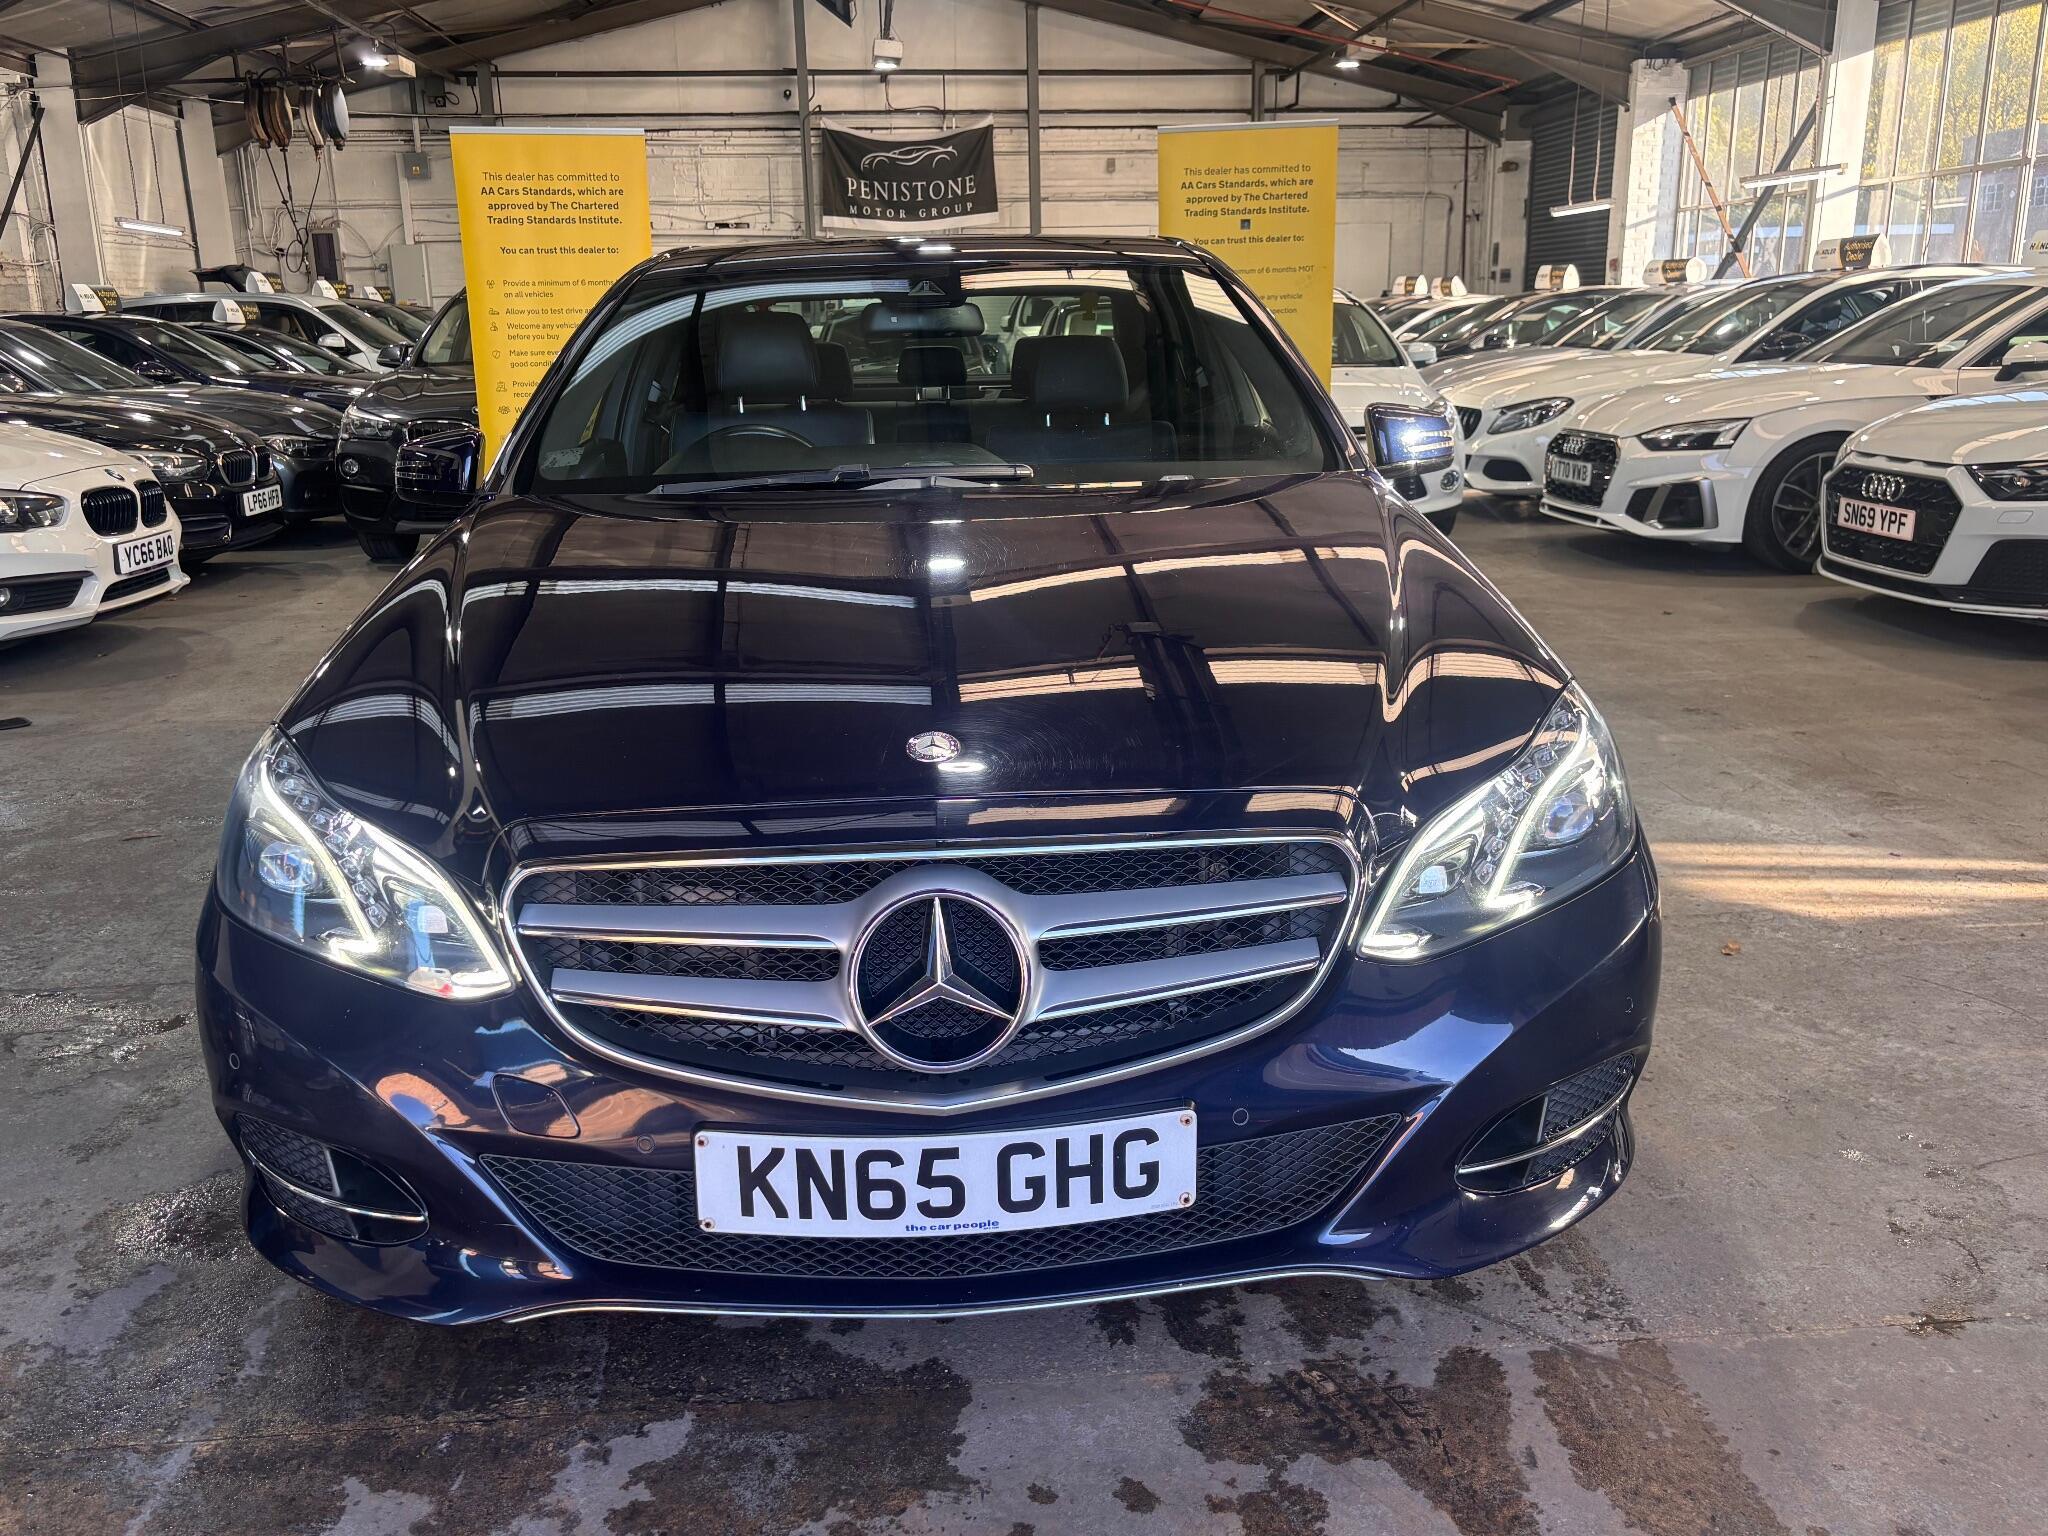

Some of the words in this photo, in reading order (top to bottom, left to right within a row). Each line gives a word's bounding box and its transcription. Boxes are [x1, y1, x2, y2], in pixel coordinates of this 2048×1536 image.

[1184, 168, 1202, 176] This
[1204, 167, 1231, 176] dealer
[1234, 166, 1249, 175] has
[1252, 165, 1300, 174] committed
[1302, 164, 1311, 172] to
[482, 172, 502, 182] This
[506, 172, 535, 182] dealer
[538, 172, 554, 182] has
[557, 172, 607, 182] committed
[846, 175, 976, 202] PENISTONE
[1181, 182, 1193, 190] AA
[1196, 181, 1217, 189] Cars
[1270, 178, 1297, 187] which
[481, 187, 495, 196] AA
[497, 187, 519, 196] Cars
[522, 187, 575, 197] Standards,
[578, 187, 607, 196] which
[1186, 194, 1228, 204] approved
[1230, 194, 1242, 202] by
[1262, 192, 1308, 200] Chartered
[488, 202, 534, 212] approved
[537, 202, 548, 212] by
[550, 202, 568, 210] The
[571, 202, 619, 210] Chartered
[850, 205, 906, 218] MOTOR
[919, 202, 973, 218] GROUP
[1184, 208, 1218, 218] Trading
[1220, 206, 1267, 216] Standards
[1269, 205, 1309, 214] Institute.
[487, 216, 524, 226] Trading
[526, 216, 576, 225] Standards
[578, 216, 622, 225] Institute.
[578, 246, 606, 254] dealer
[247, 492, 268, 512] LP66
[1844, 502, 1876, 528] SN69
[1880, 509, 1908, 534] YPF
[124, 541, 155, 568] YC66
[156, 535, 174, 559] BAO
[736, 1144, 966, 1220] KN65
[996, 1127, 1160, 1214] GHG
[953, 1220, 1000, 1230] people
